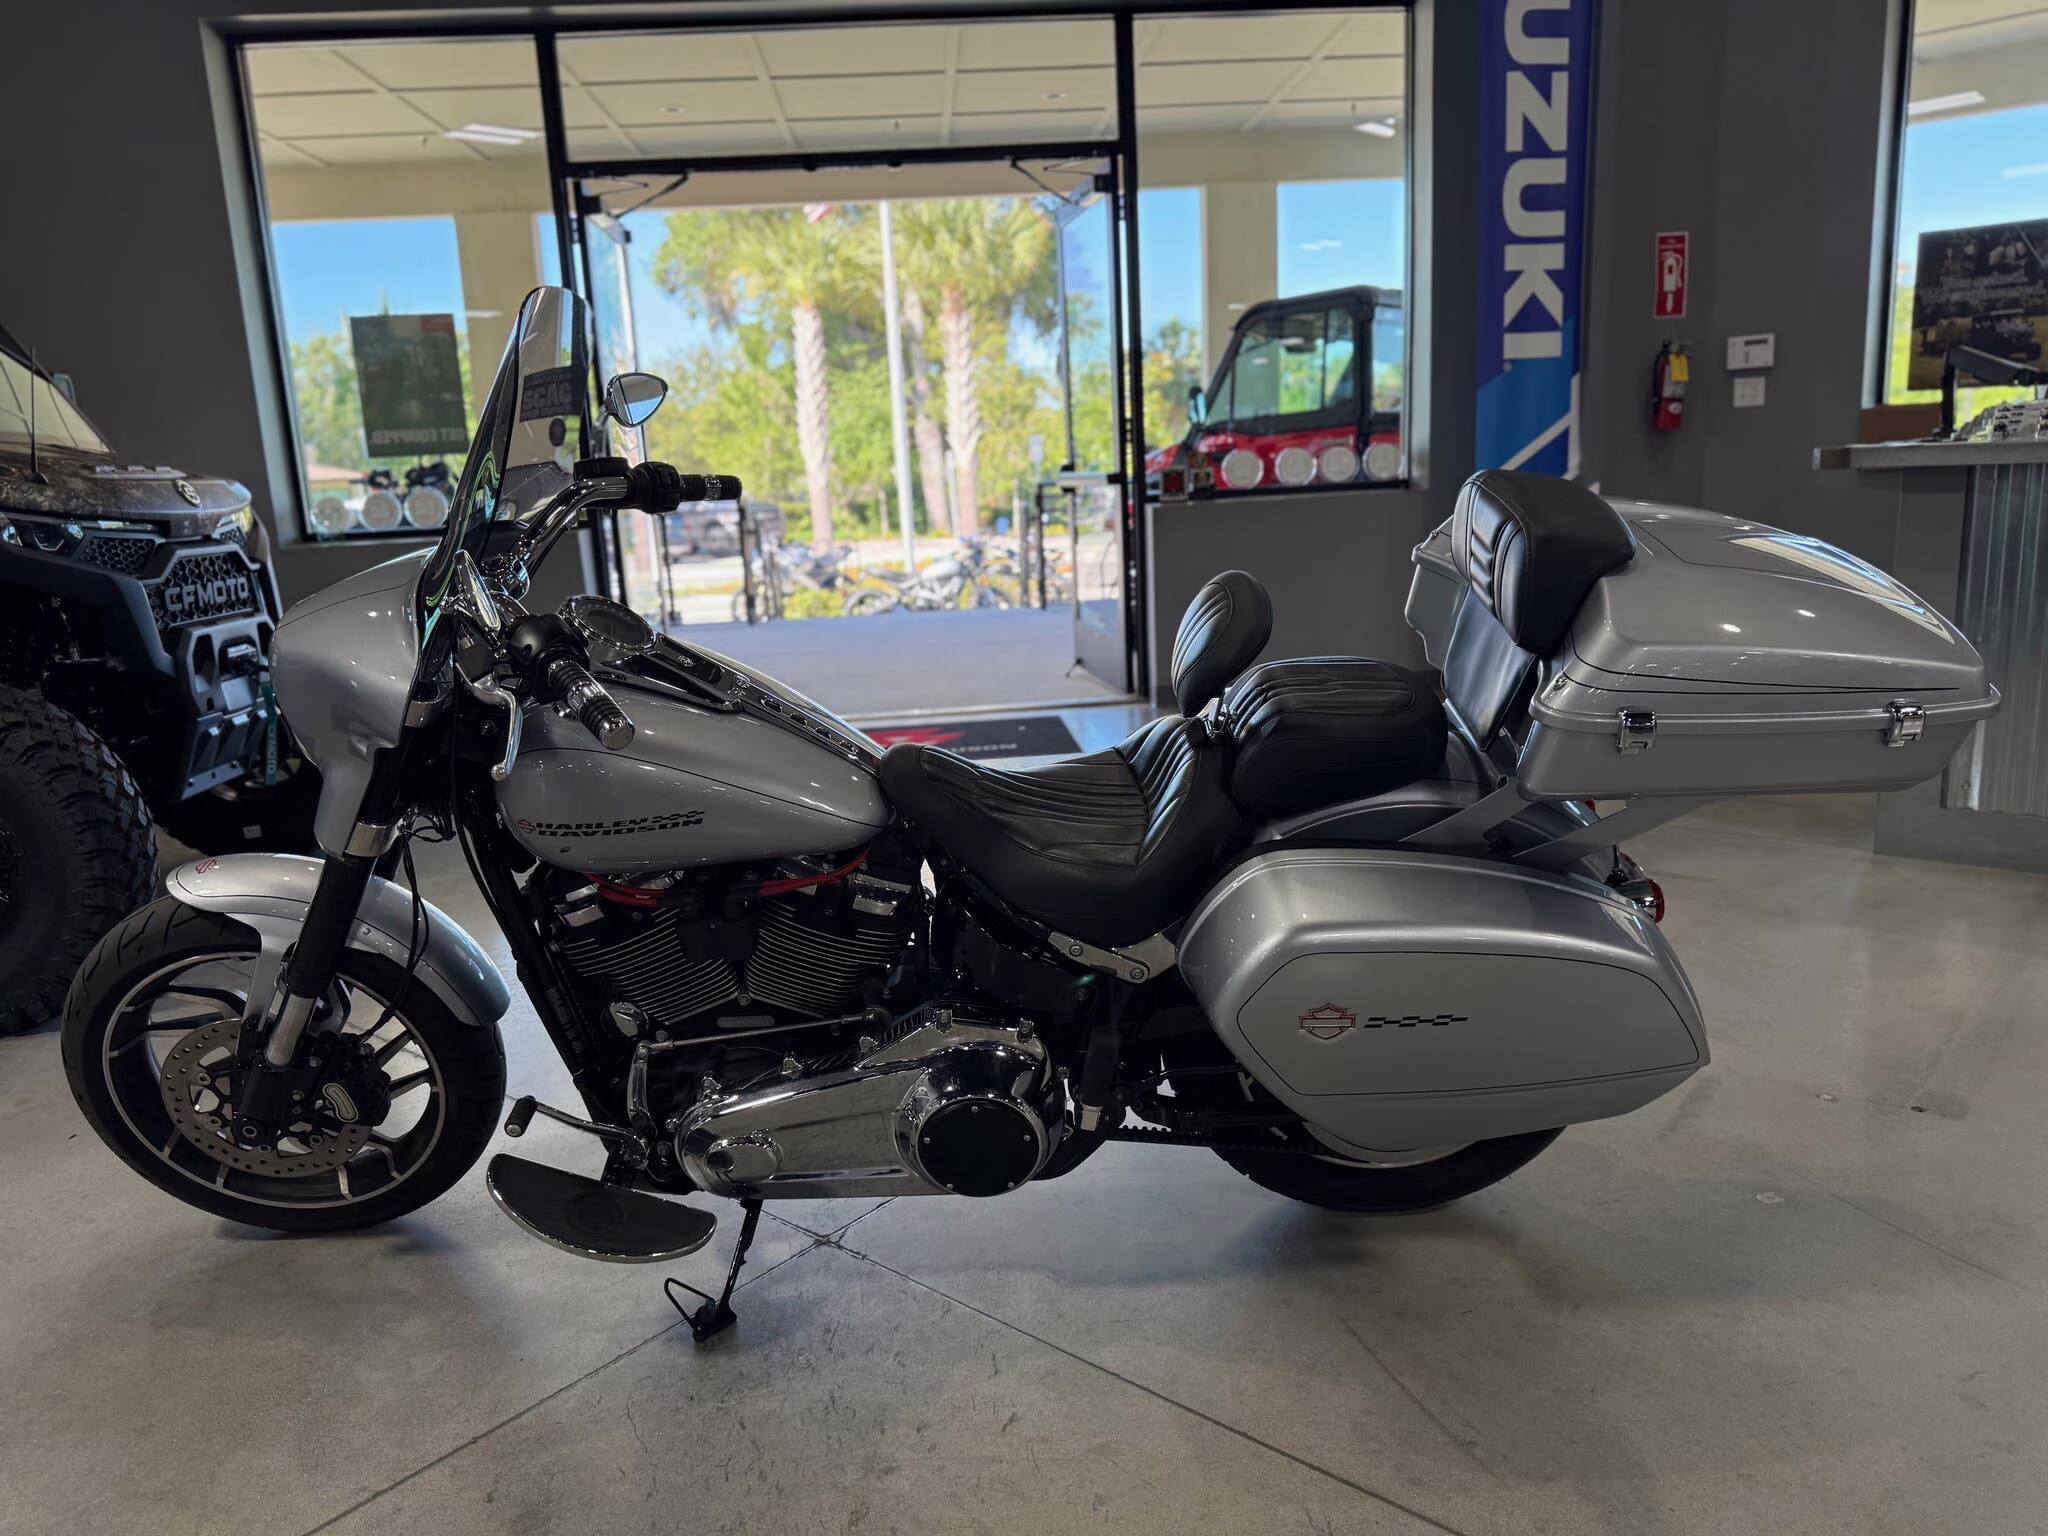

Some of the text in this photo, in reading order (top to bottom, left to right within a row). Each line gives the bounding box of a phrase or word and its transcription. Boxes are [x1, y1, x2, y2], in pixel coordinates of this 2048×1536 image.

[165, 576, 249, 612] CFMOTO
[536, 818, 649, 830] HARLEY
[538, 818, 704, 837] DAVIDSON
